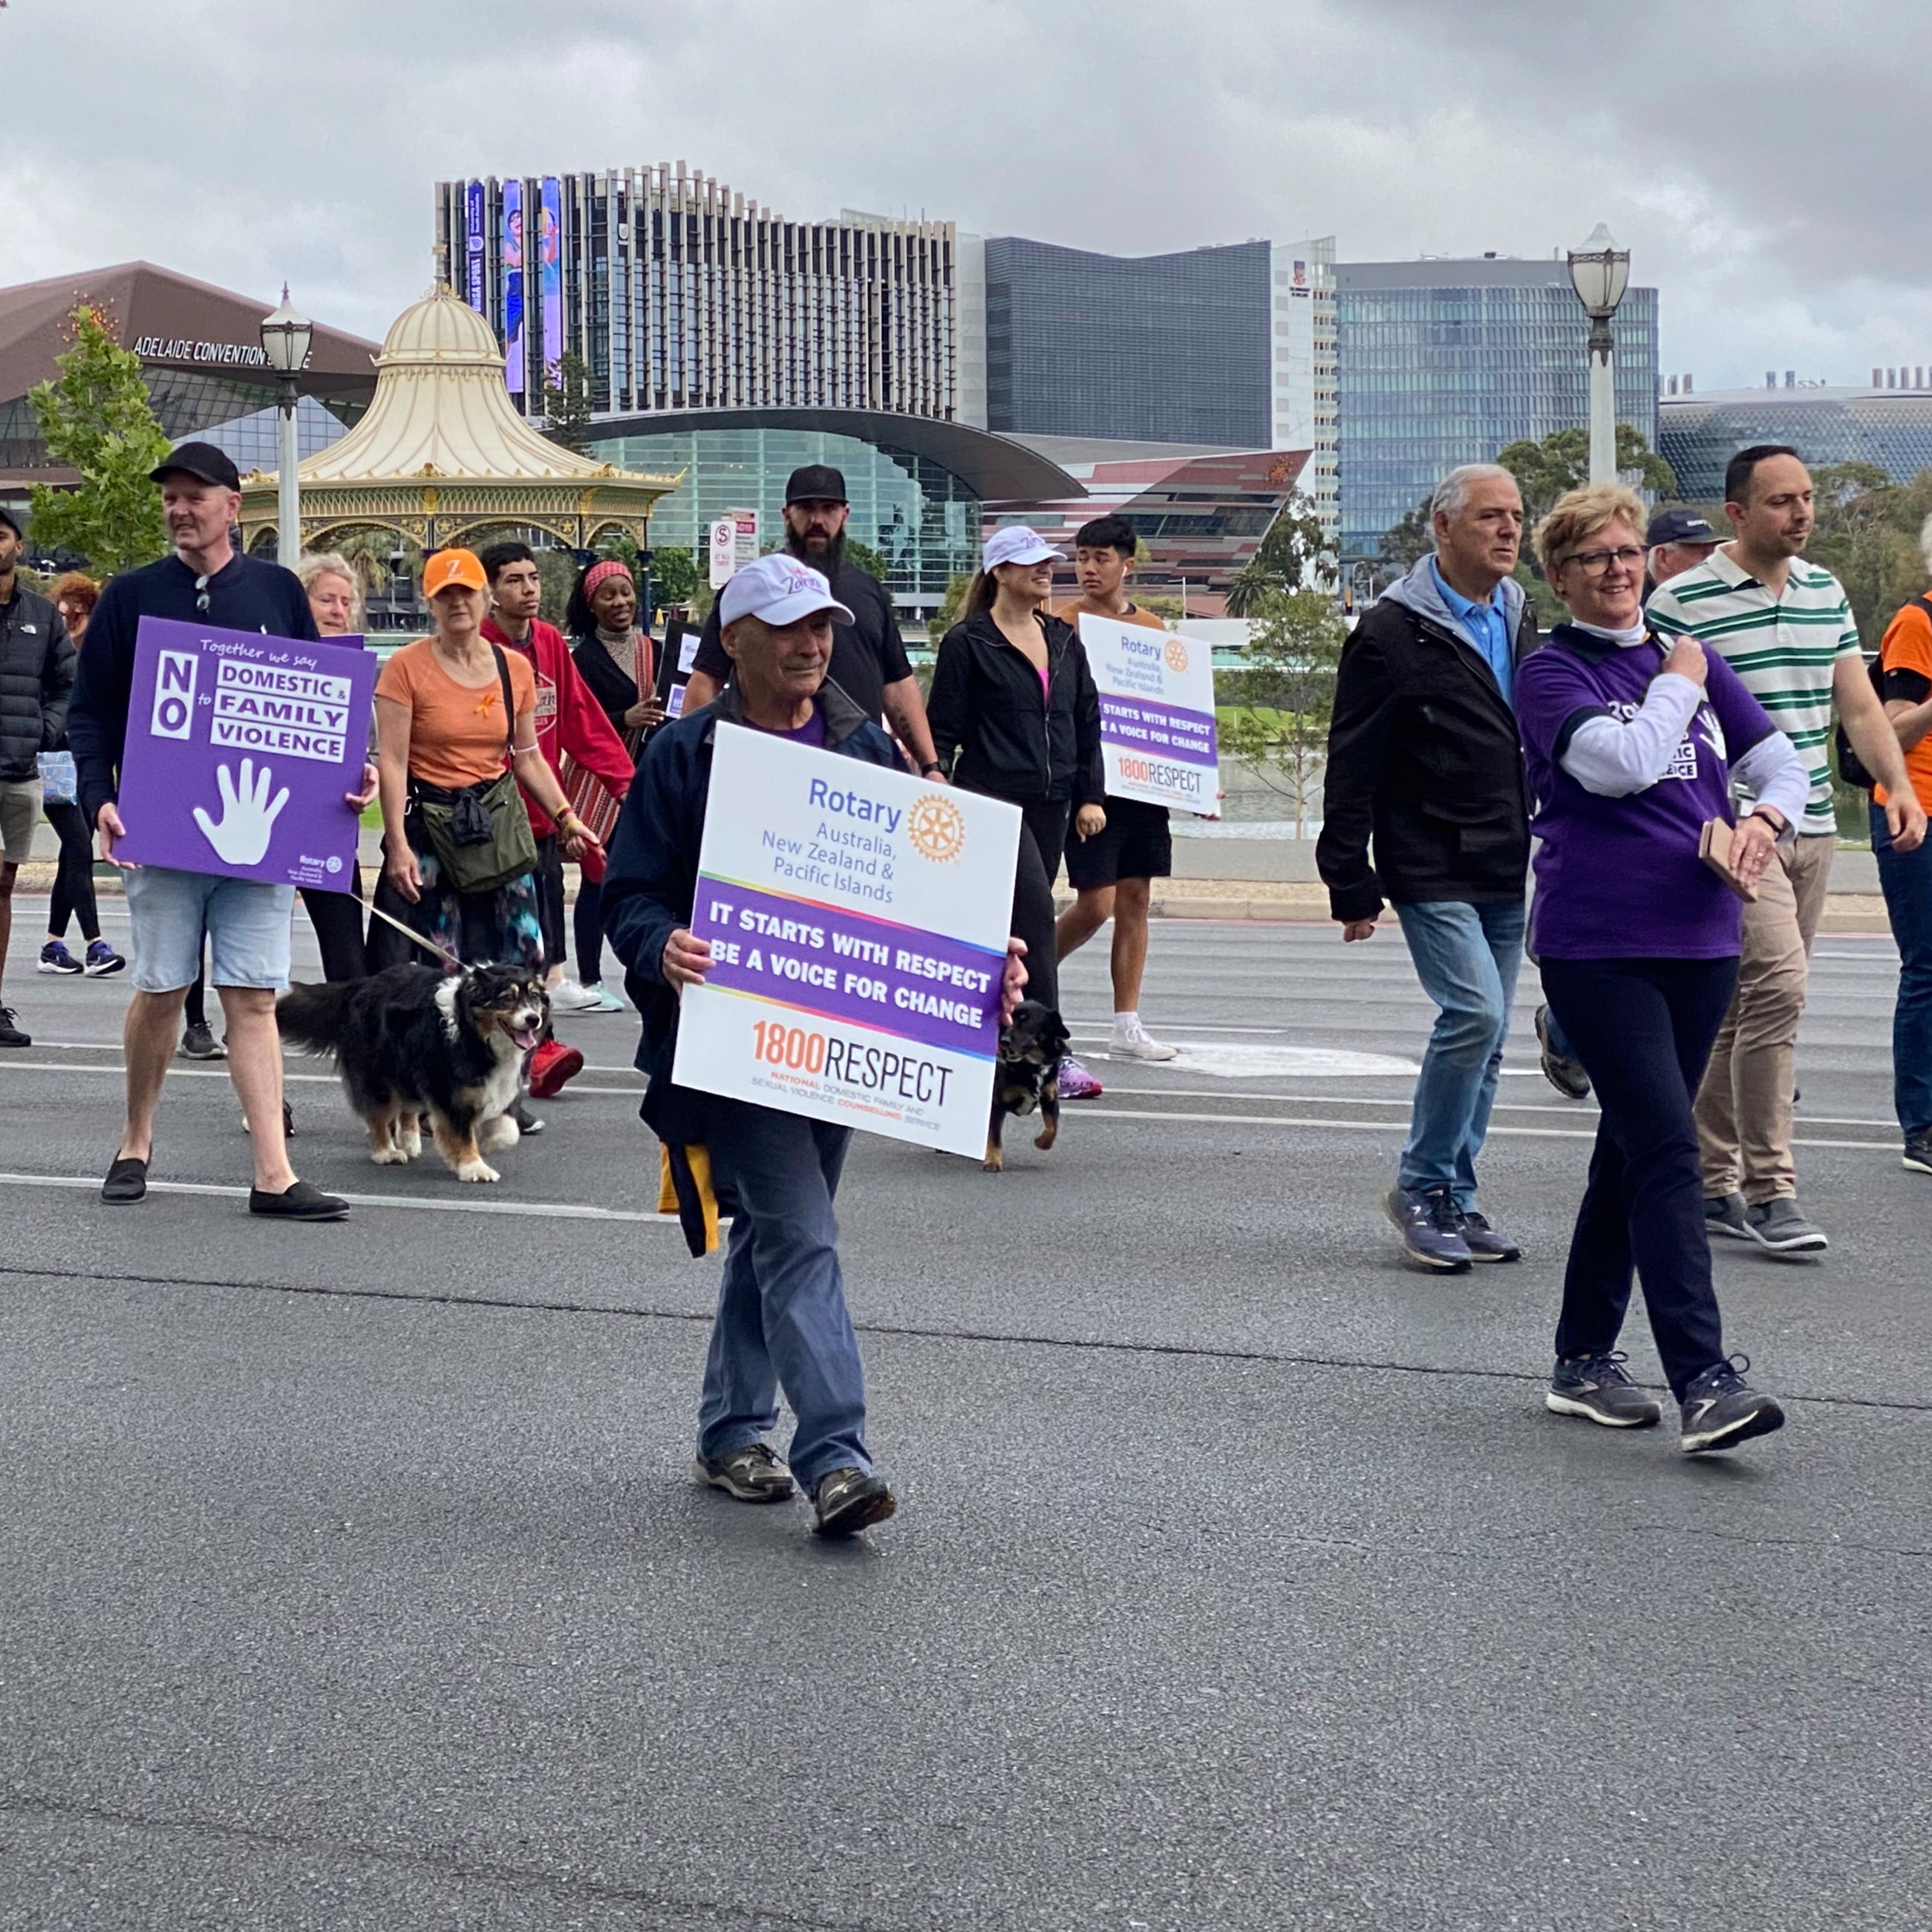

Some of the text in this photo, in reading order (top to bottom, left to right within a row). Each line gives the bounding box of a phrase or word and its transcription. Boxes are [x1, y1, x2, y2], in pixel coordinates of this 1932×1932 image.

[471, 258, 481, 286] SPORT
[134, 336, 193, 359] ADELAIDE
[193, 342, 266, 365] CONVENTION
[200, 639, 318, 671] Together we say
[1121, 636, 1161, 661] Rotary
[222, 665, 346, 700] DOMESTIC &
[1112, 676, 1137, 689] Pacific
[1125, 668, 1155, 682] Zealand
[198, 693, 212, 705] to
[220, 694, 344, 728] FAMILY
[1103, 703, 1211, 736] STARTS WITH RESPECT
[218, 723, 341, 757] VIOLENCE
[1109, 722, 1117, 734] A
[1119, 725, 1148, 740] VOICE
[1149, 731, 1169, 745] FOR
[1172, 736, 1210, 754] CHANGE
[1118, 757, 1201, 793] 1800RESPECT
[809, 777, 902, 834] Rotary
[762, 829, 893, 881] New Zealand &
[816, 822, 896, 861] Australia,
[299, 855, 325, 868] Rotary
[774, 856, 892, 903] Pacific Islands
[709, 901, 991, 993] IT STARTS WITH RESPECT
[709, 939, 983, 1029] BE A VOICE FOR CHANGE
[753, 1019, 953, 1106] 1800RESPECT
[751, 1077, 941, 1132] SEXUAL VIOLENCE COUNSELLING SERVICE
[771, 1071, 924, 1116] NATIONAL DOMESTIC FAMILY AND
